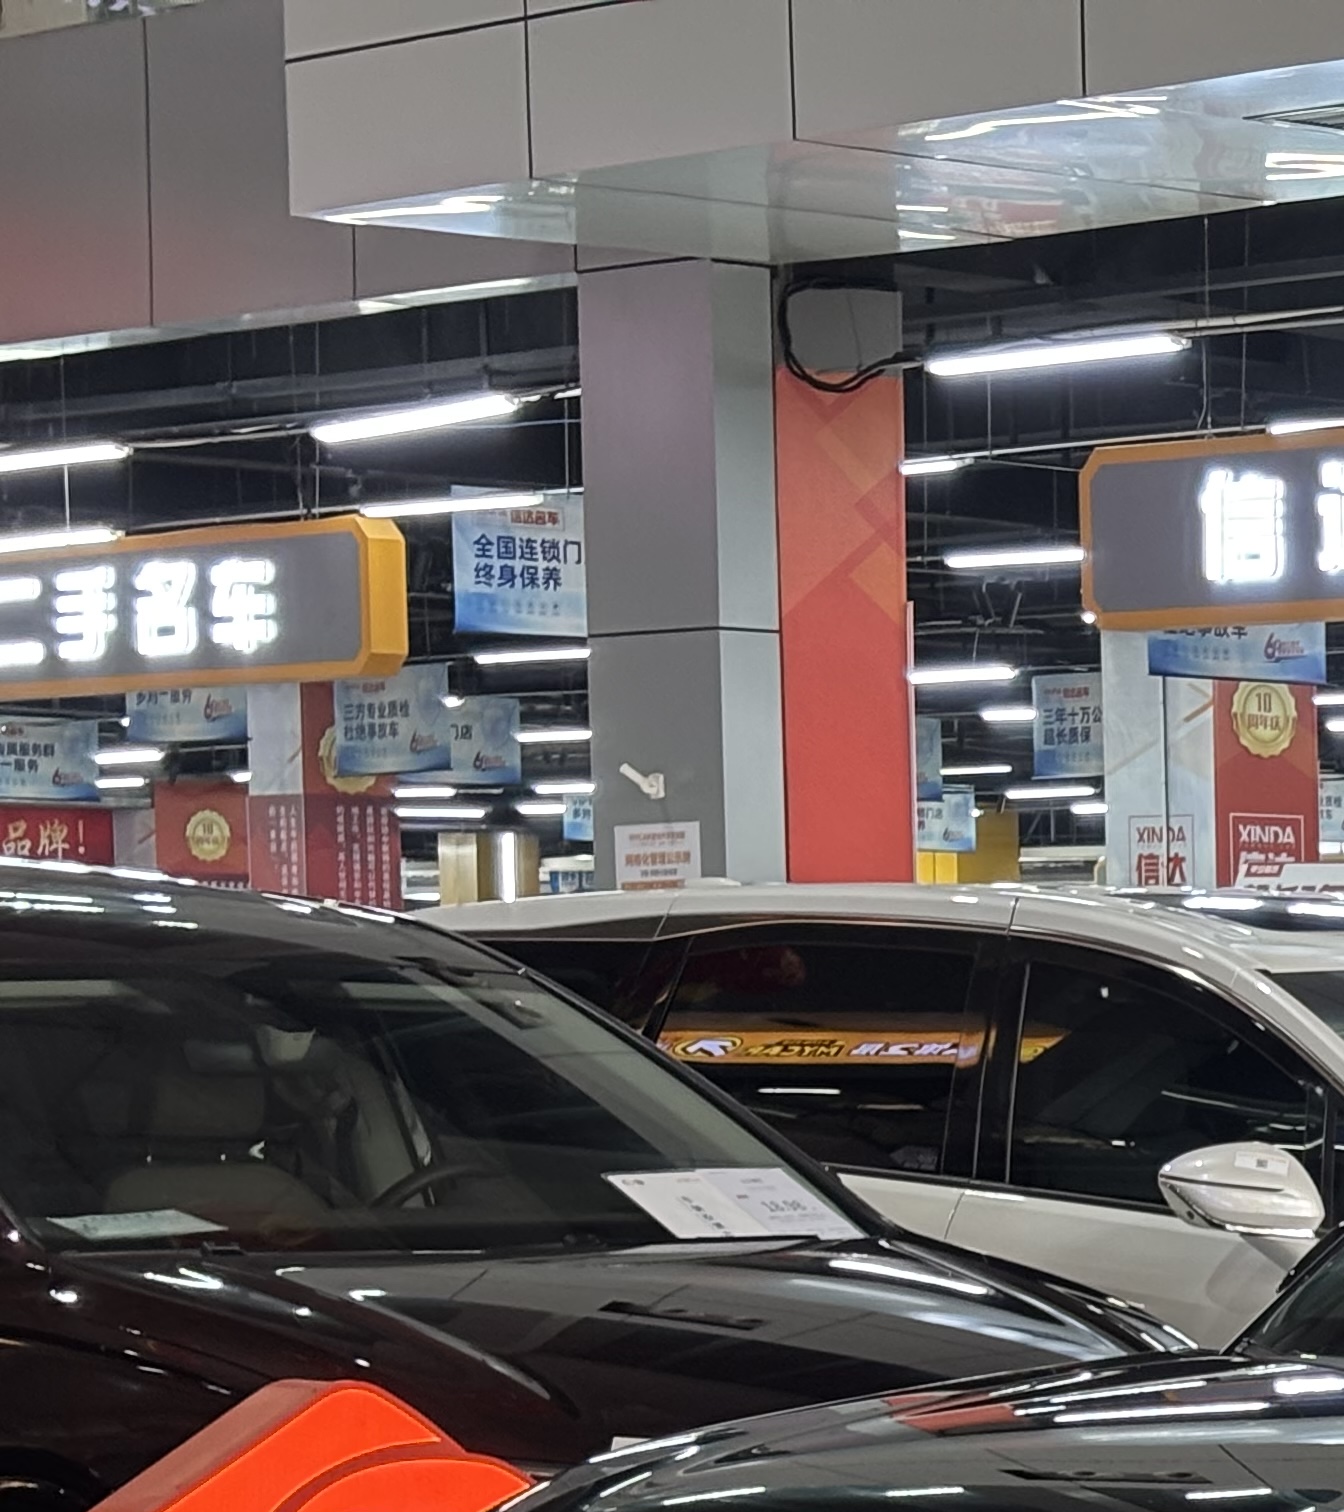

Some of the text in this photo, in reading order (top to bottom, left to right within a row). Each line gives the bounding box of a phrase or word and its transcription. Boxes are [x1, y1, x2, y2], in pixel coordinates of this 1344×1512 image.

[473, 533, 582, 565] 全国连锁门
[474, 562, 562, 591] 终身保养
[0, 558, 276, 664] 二手名车
[1239, 824, 1295, 844] XINDA
